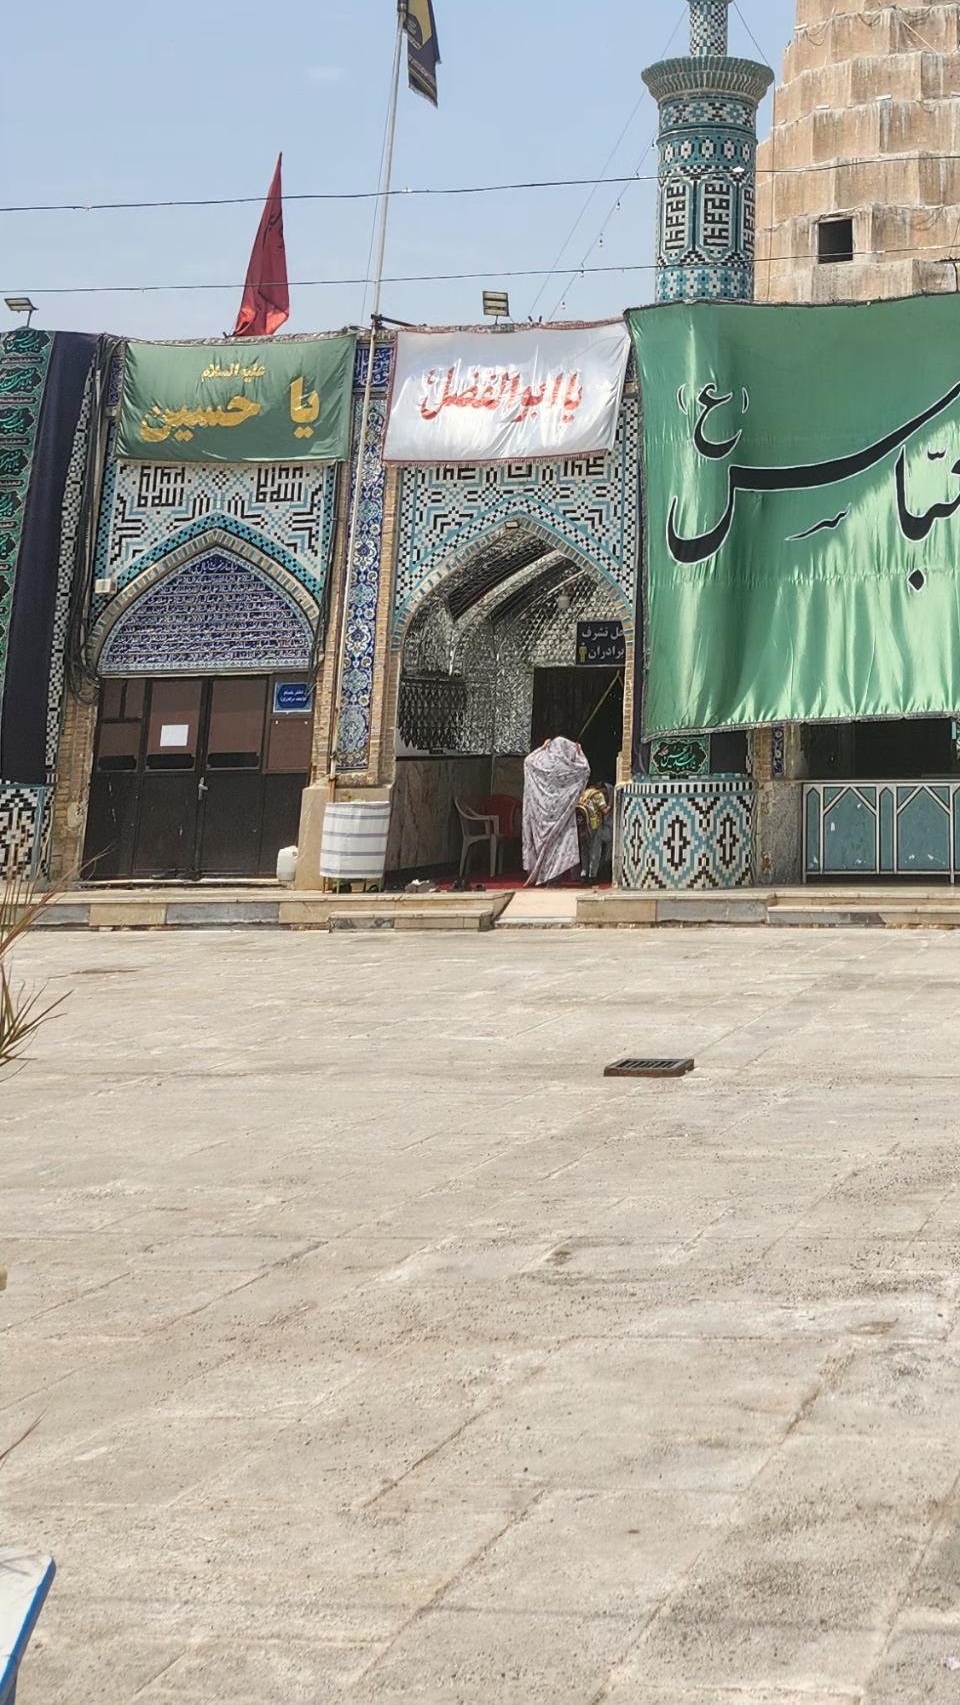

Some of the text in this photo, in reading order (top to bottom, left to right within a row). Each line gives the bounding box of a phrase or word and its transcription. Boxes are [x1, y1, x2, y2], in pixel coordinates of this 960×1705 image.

[139, 375, 320, 443] یا حسین
[581, 626, 609, 641] تشرف
